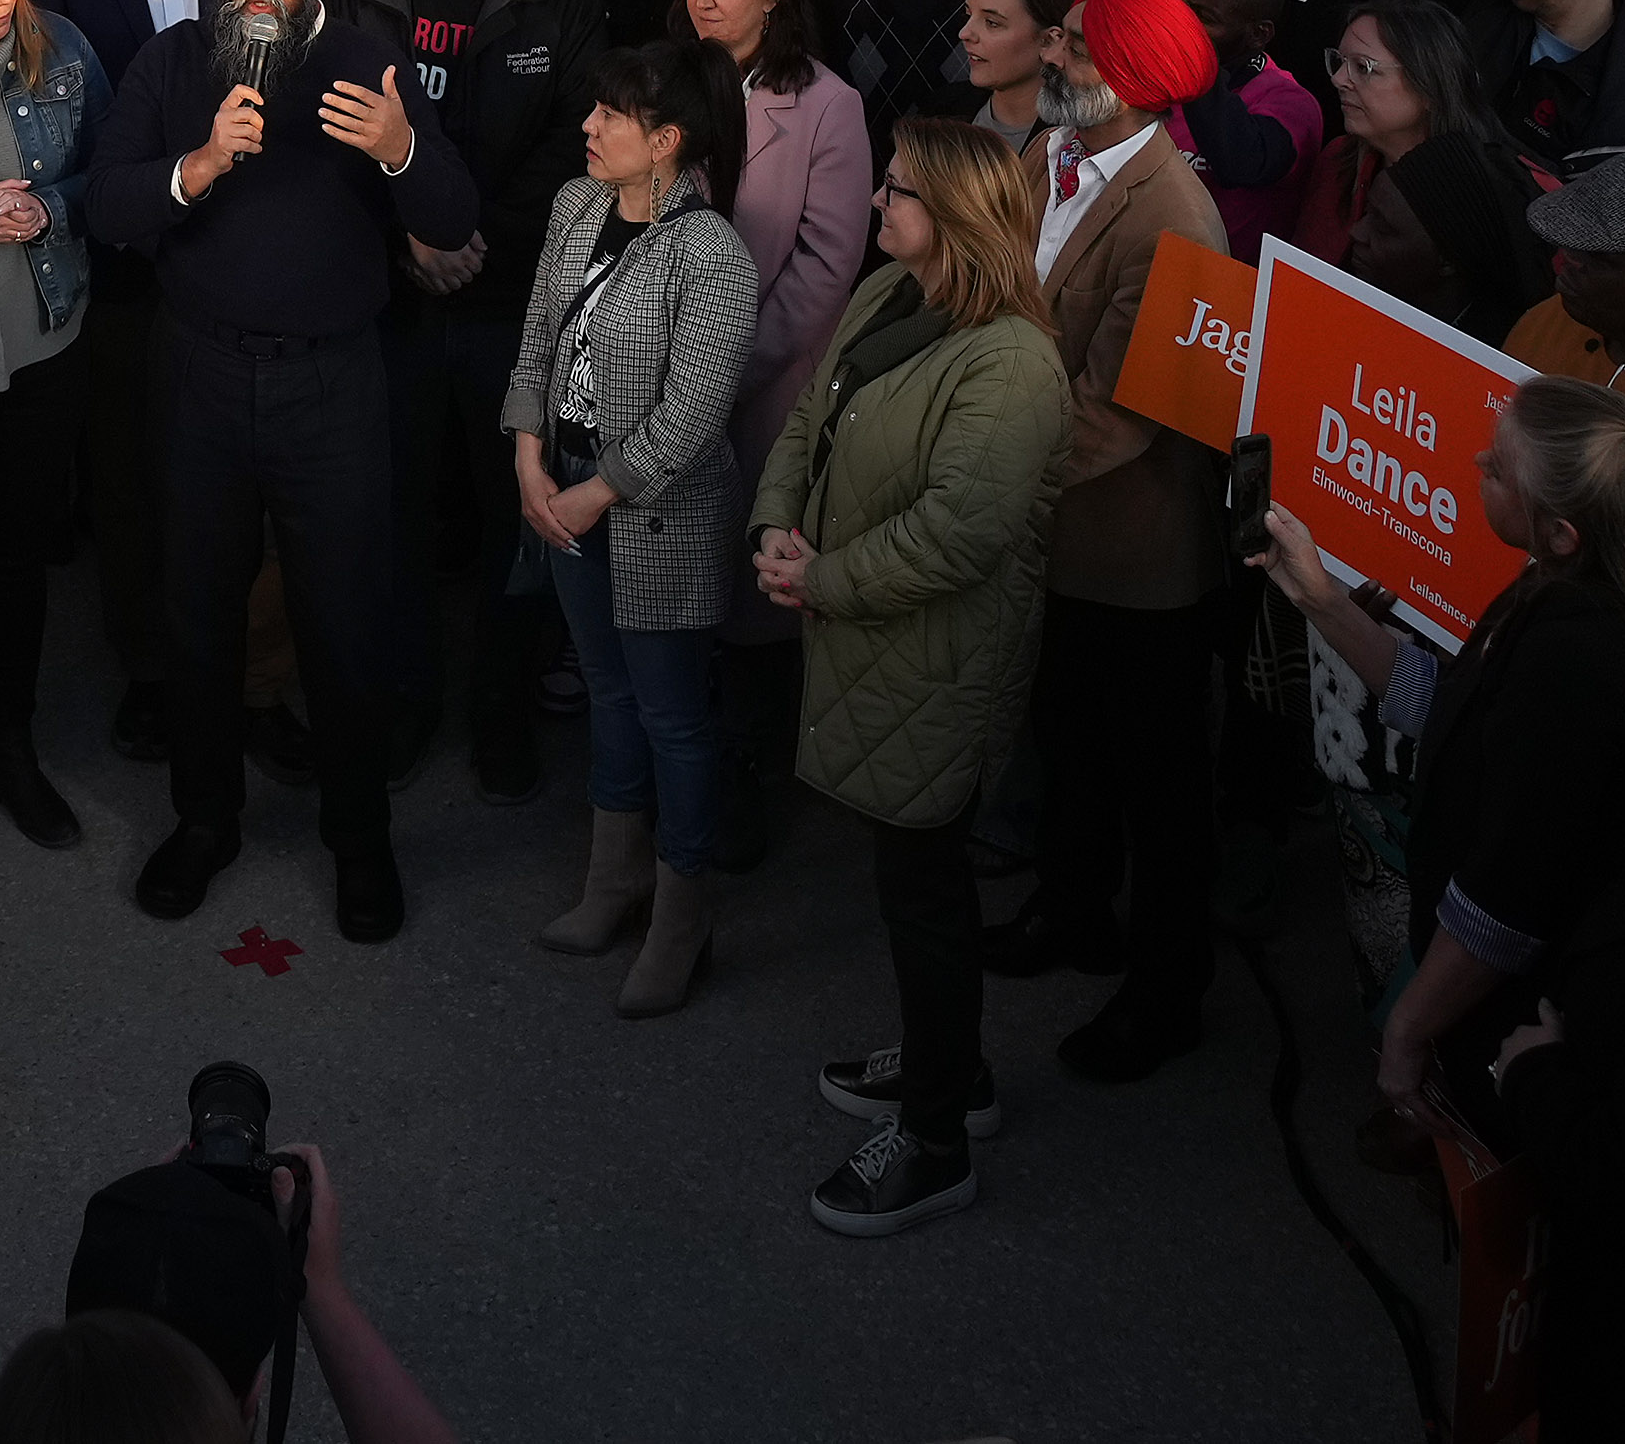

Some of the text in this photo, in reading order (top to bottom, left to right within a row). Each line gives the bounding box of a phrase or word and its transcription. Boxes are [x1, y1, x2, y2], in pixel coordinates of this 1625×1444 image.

[506, 55, 550, 68] Federation
[520, 65, 551, 75] Labour
[1351, 363, 1437, 453] Leila
[1316, 405, 1458, 533] Dance
